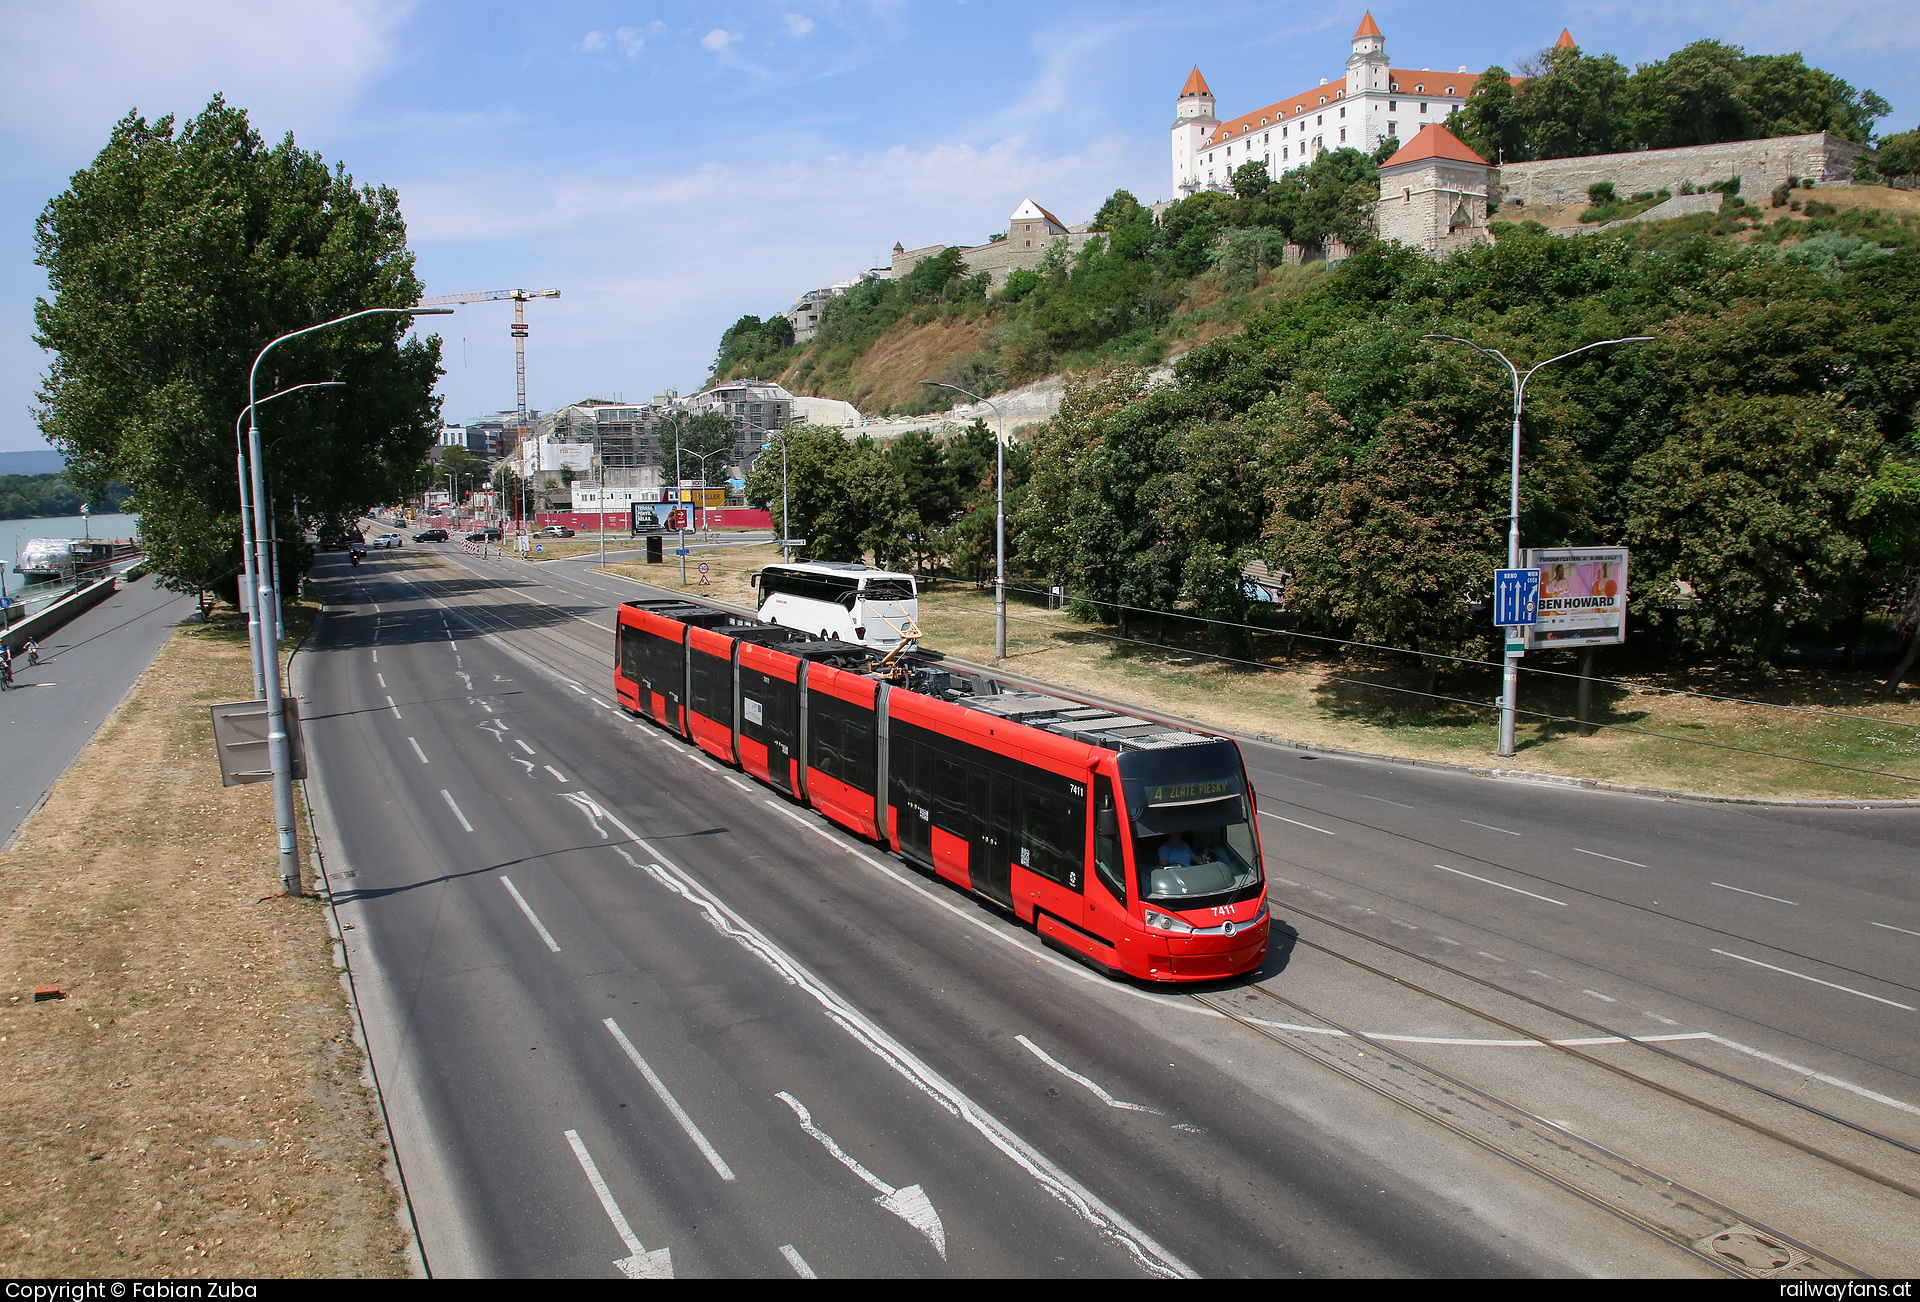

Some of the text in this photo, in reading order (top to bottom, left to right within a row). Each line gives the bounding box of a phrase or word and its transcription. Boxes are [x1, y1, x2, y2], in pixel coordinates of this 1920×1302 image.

[1538, 597, 1614, 610] BEN HOWARD
[1069, 783, 1084, 797] 7411
[1154, 786, 1163, 801] 4
[1199, 781, 1228, 795] PIESKY
[1211, 905, 1236, 917] 7411
